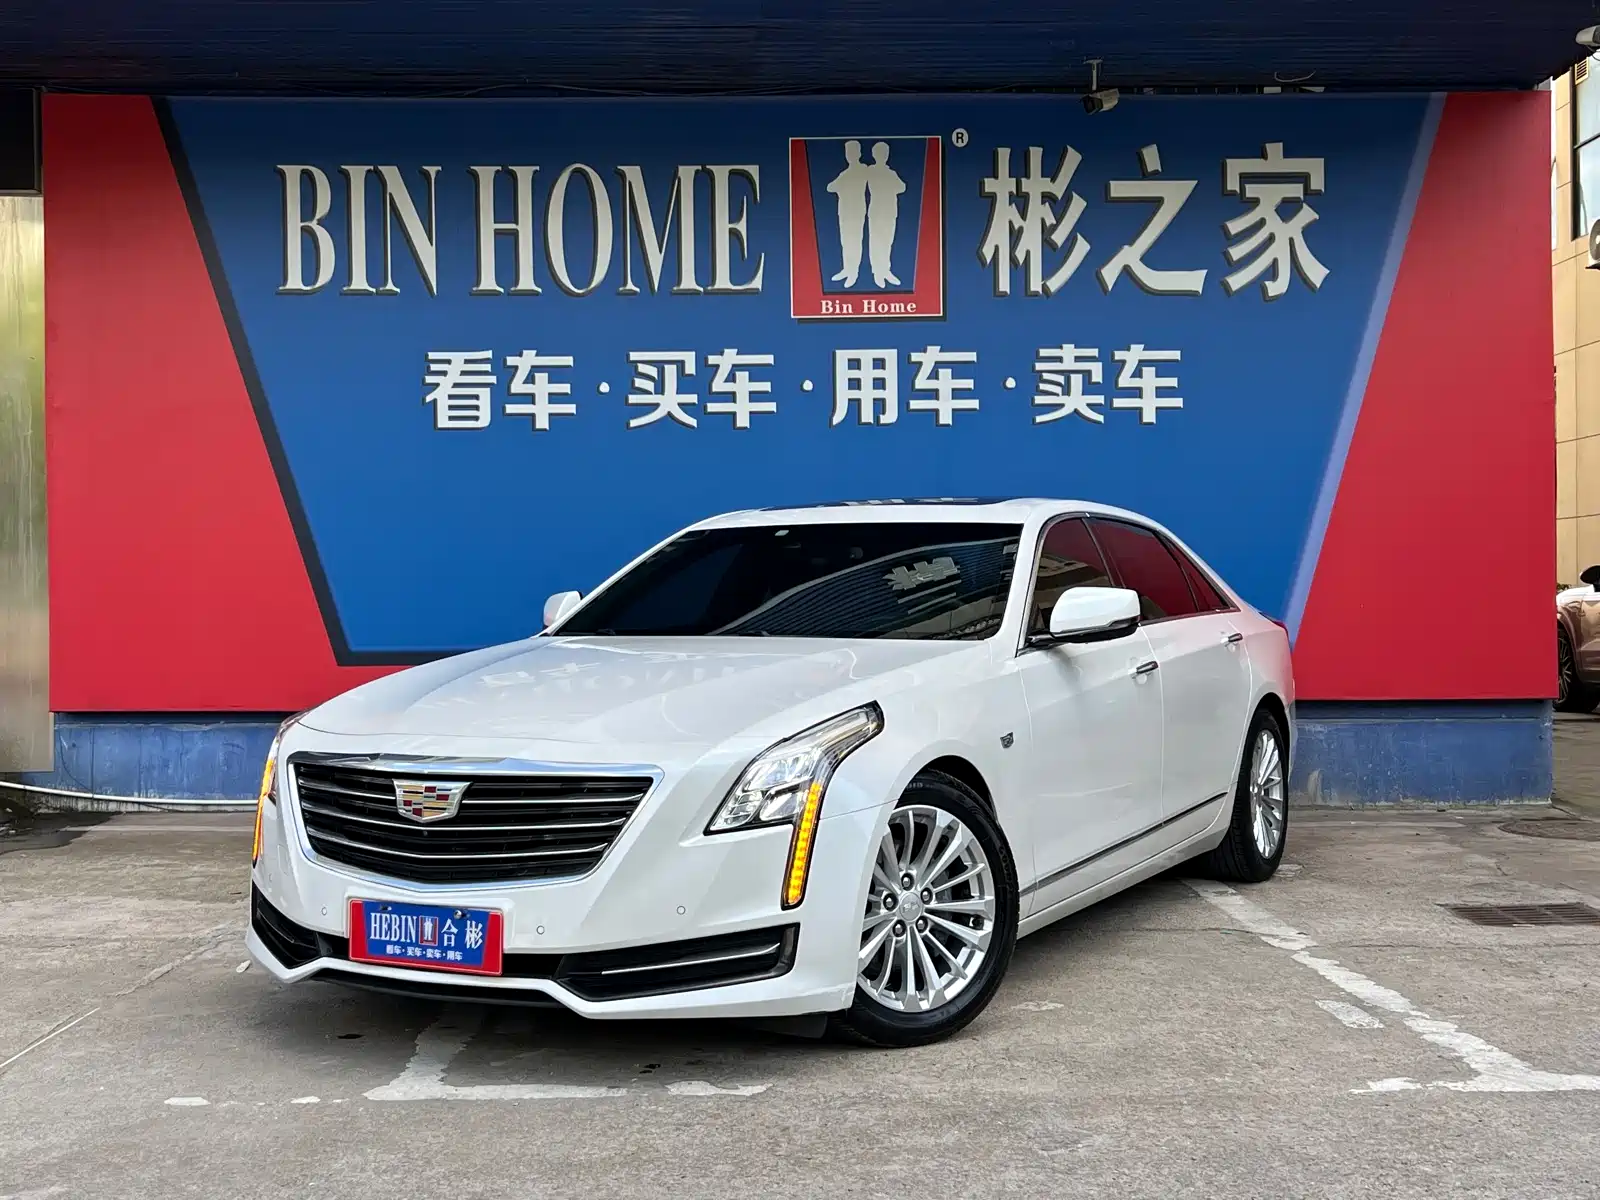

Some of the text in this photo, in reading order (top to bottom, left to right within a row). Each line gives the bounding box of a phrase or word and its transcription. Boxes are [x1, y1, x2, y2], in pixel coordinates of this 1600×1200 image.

[276, 162, 765, 296] BIN HOME
[980, 142, 1330, 299] 彬之家
[820, 299, 917, 314] Bin Home
[370, 912, 417, 943] HEBIN
[441, 918, 483, 949] 合彬
